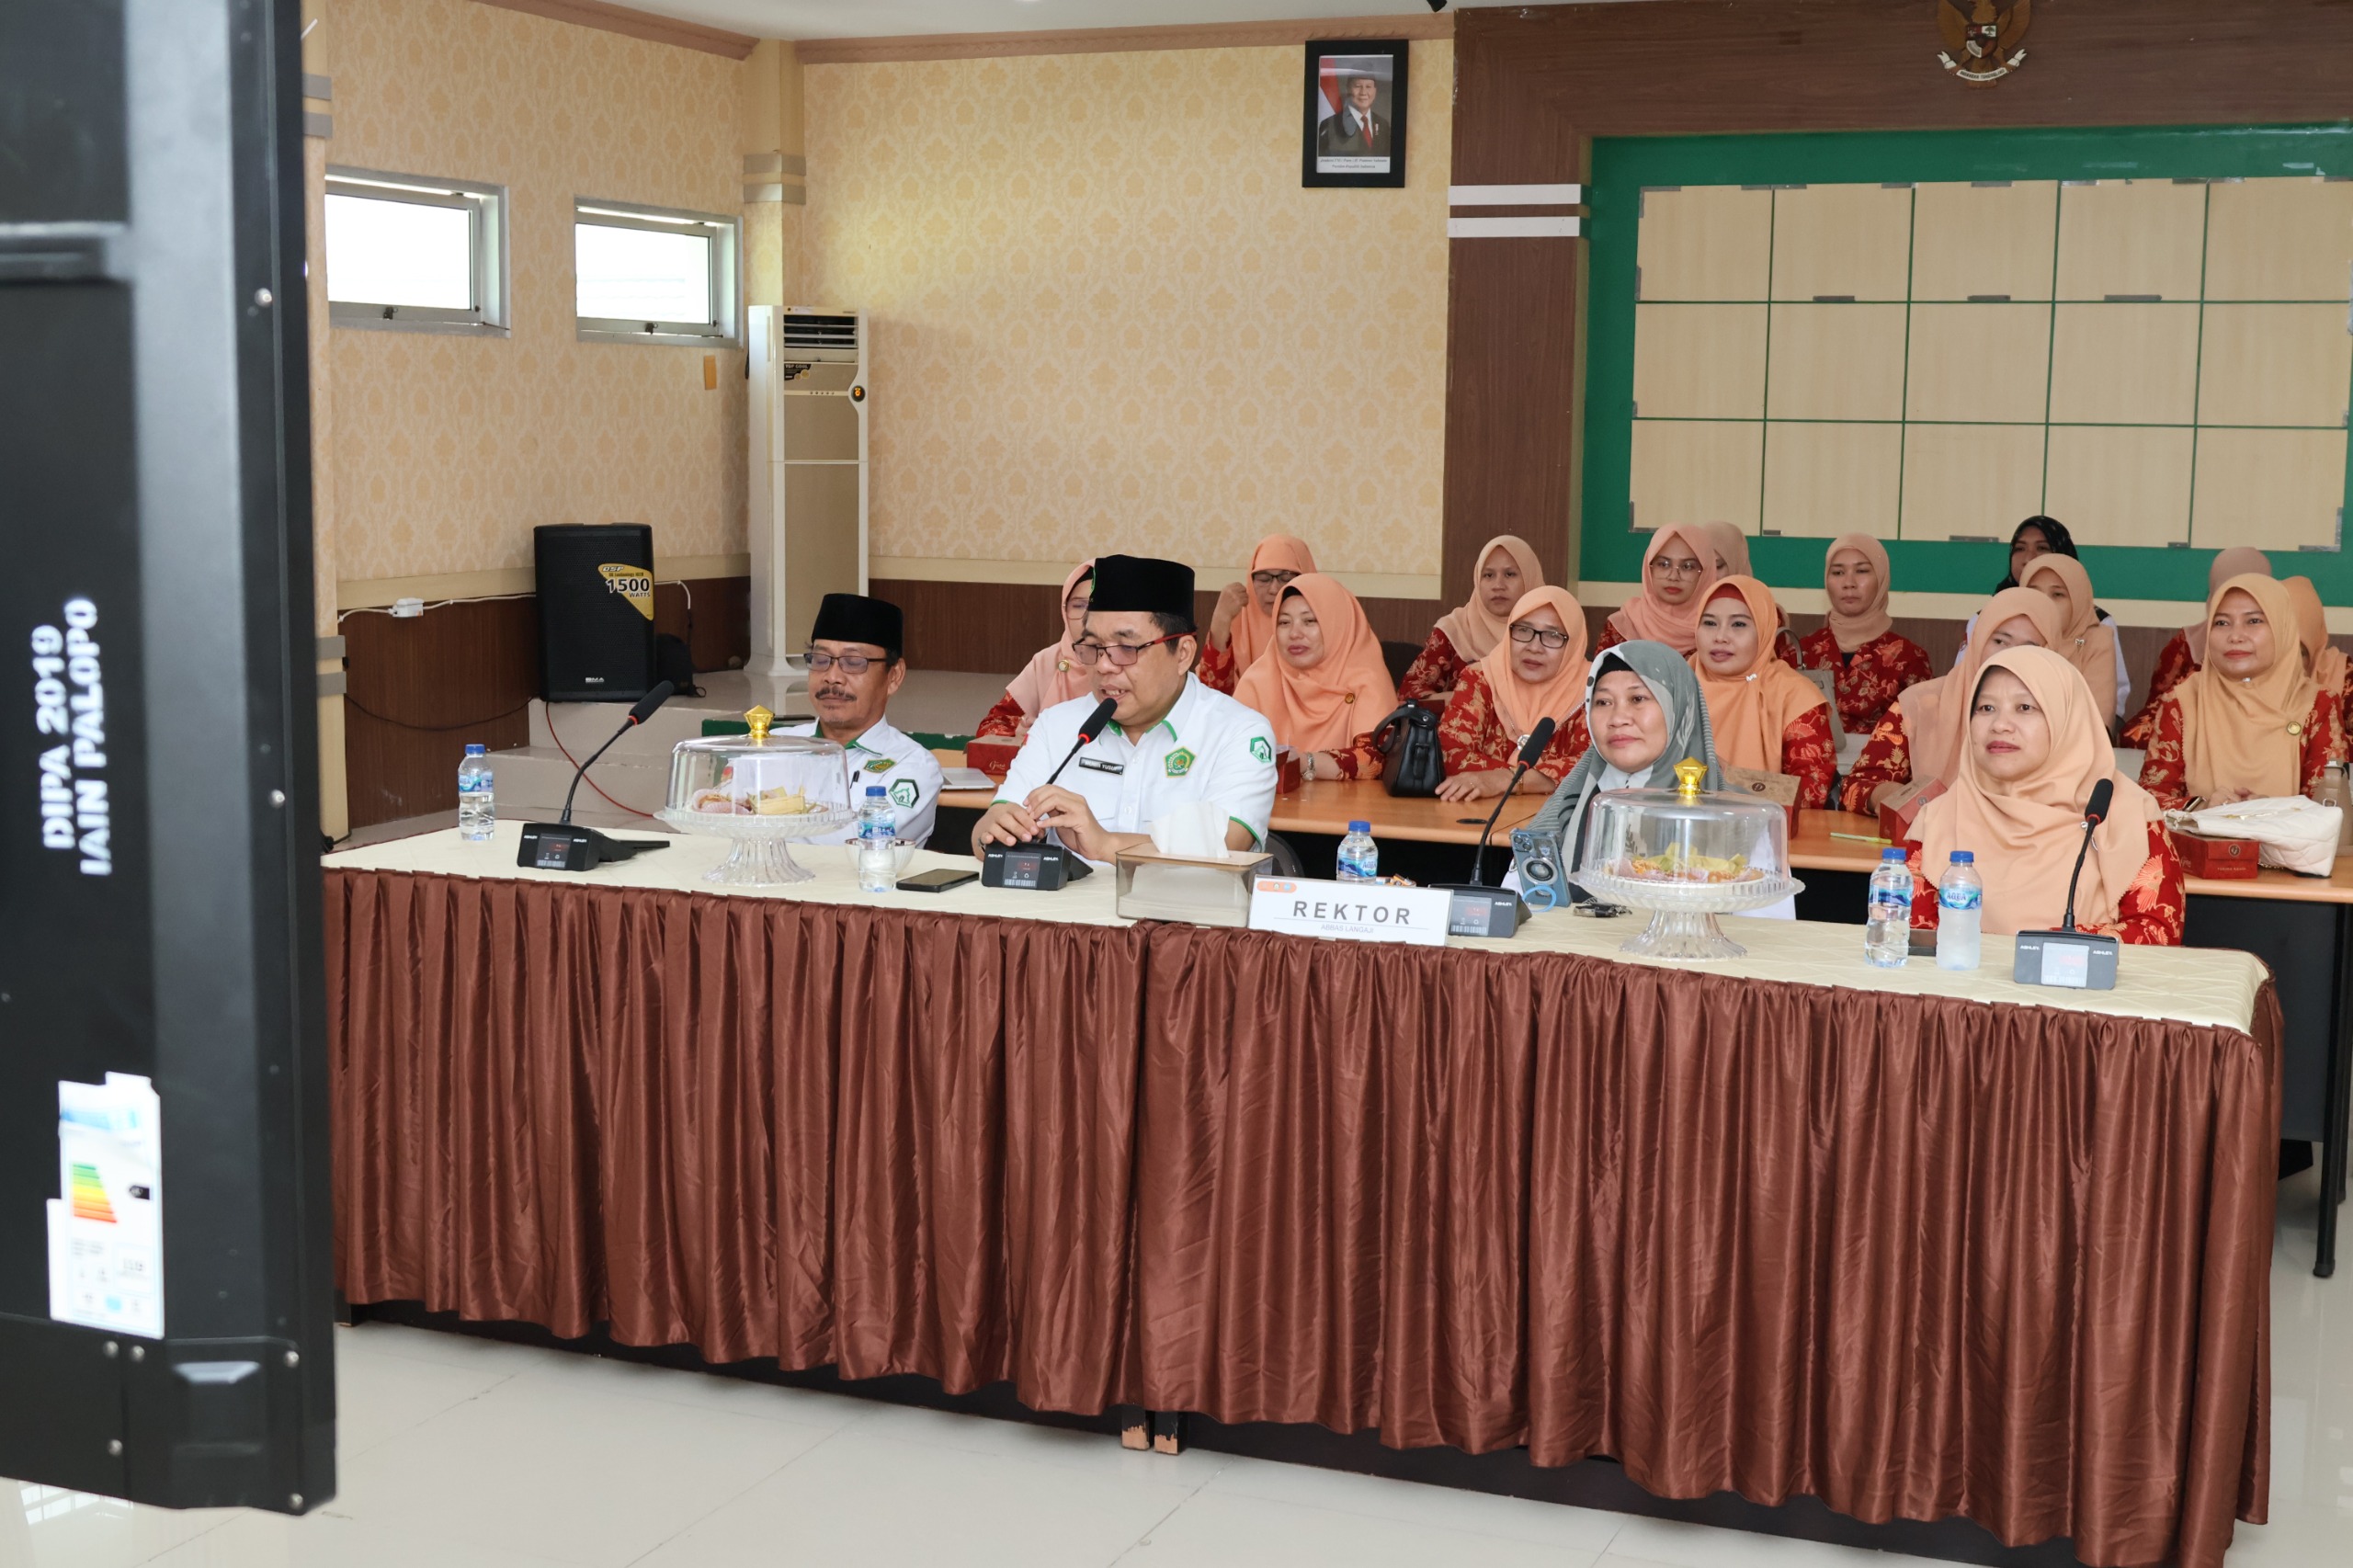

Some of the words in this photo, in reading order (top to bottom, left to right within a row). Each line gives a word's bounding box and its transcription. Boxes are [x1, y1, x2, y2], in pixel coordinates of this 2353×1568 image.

[607, 578, 650, 593] 1500
[31, 624, 69, 735] 2019
[63, 597, 108, 768] PALOPO
[39, 744, 75, 849] DIPA
[75, 779, 112, 876] IAIN
[1292, 900, 1411, 926] REKTOR
[1321, 924, 1344, 932] ABBAS
